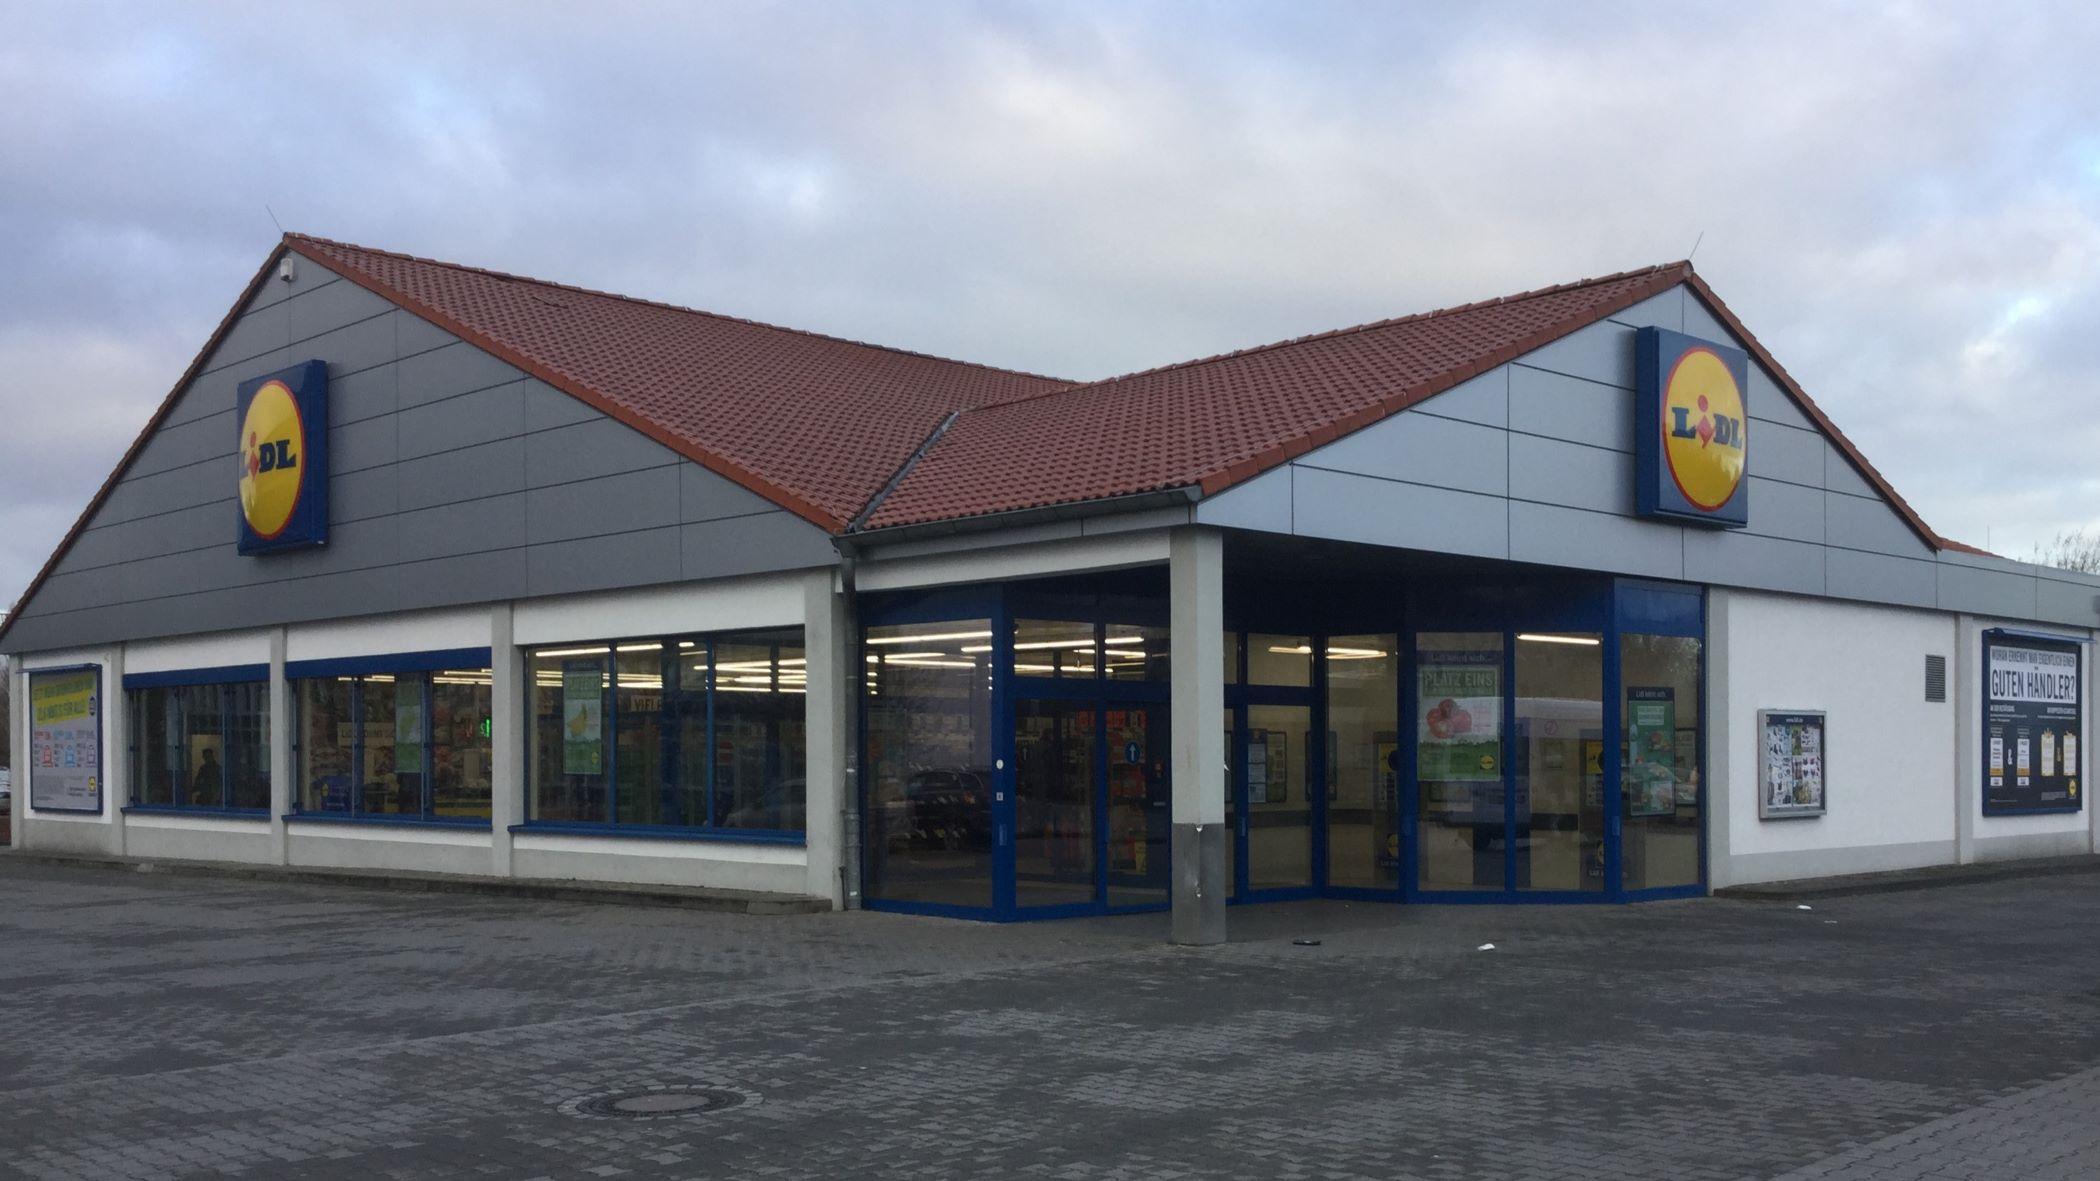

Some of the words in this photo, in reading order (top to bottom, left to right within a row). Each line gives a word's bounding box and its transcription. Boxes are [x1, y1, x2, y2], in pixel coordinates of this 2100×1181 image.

[1424, 671, 1461, 687] PLATZ
[1464, 671, 1493, 687] EINS
[1992, 669, 2024, 698] GUTEN
[2027, 666, 2075, 700] HÄNDLER?
